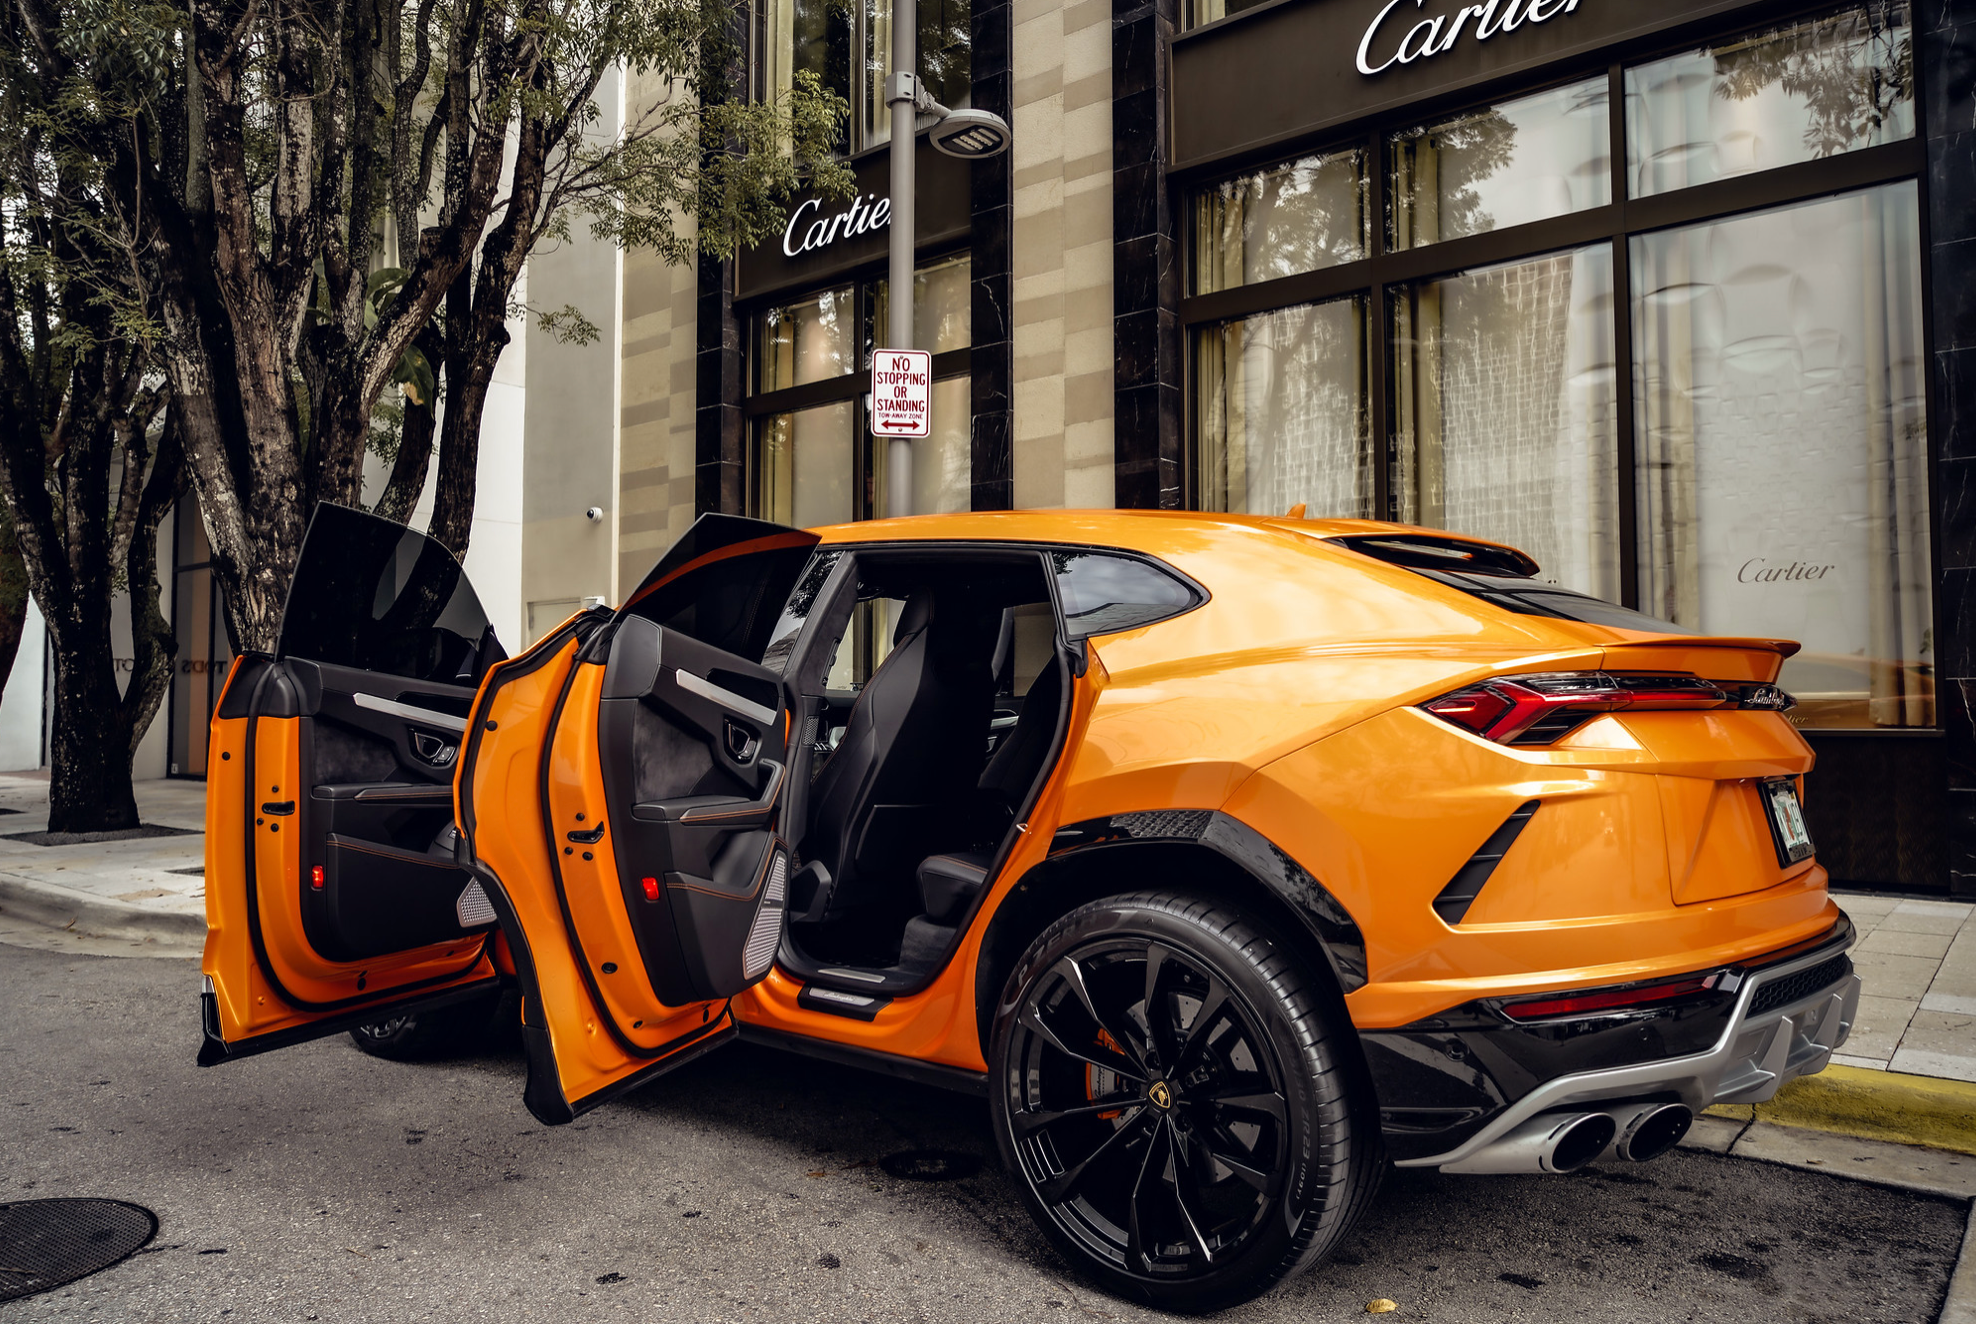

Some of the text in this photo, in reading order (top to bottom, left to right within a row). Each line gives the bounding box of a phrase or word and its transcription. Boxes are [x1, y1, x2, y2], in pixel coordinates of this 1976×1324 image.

[1356, 0, 1580, 75] Cartie
[782, 191, 891, 257] Cartie
[892, 357, 910, 372] NO
[877, 371, 926, 386] STOPPING
[893, 386, 908, 399] OR
[877, 399, 925, 412] STANDING
[1737, 557, 1835, 584] Cartier
